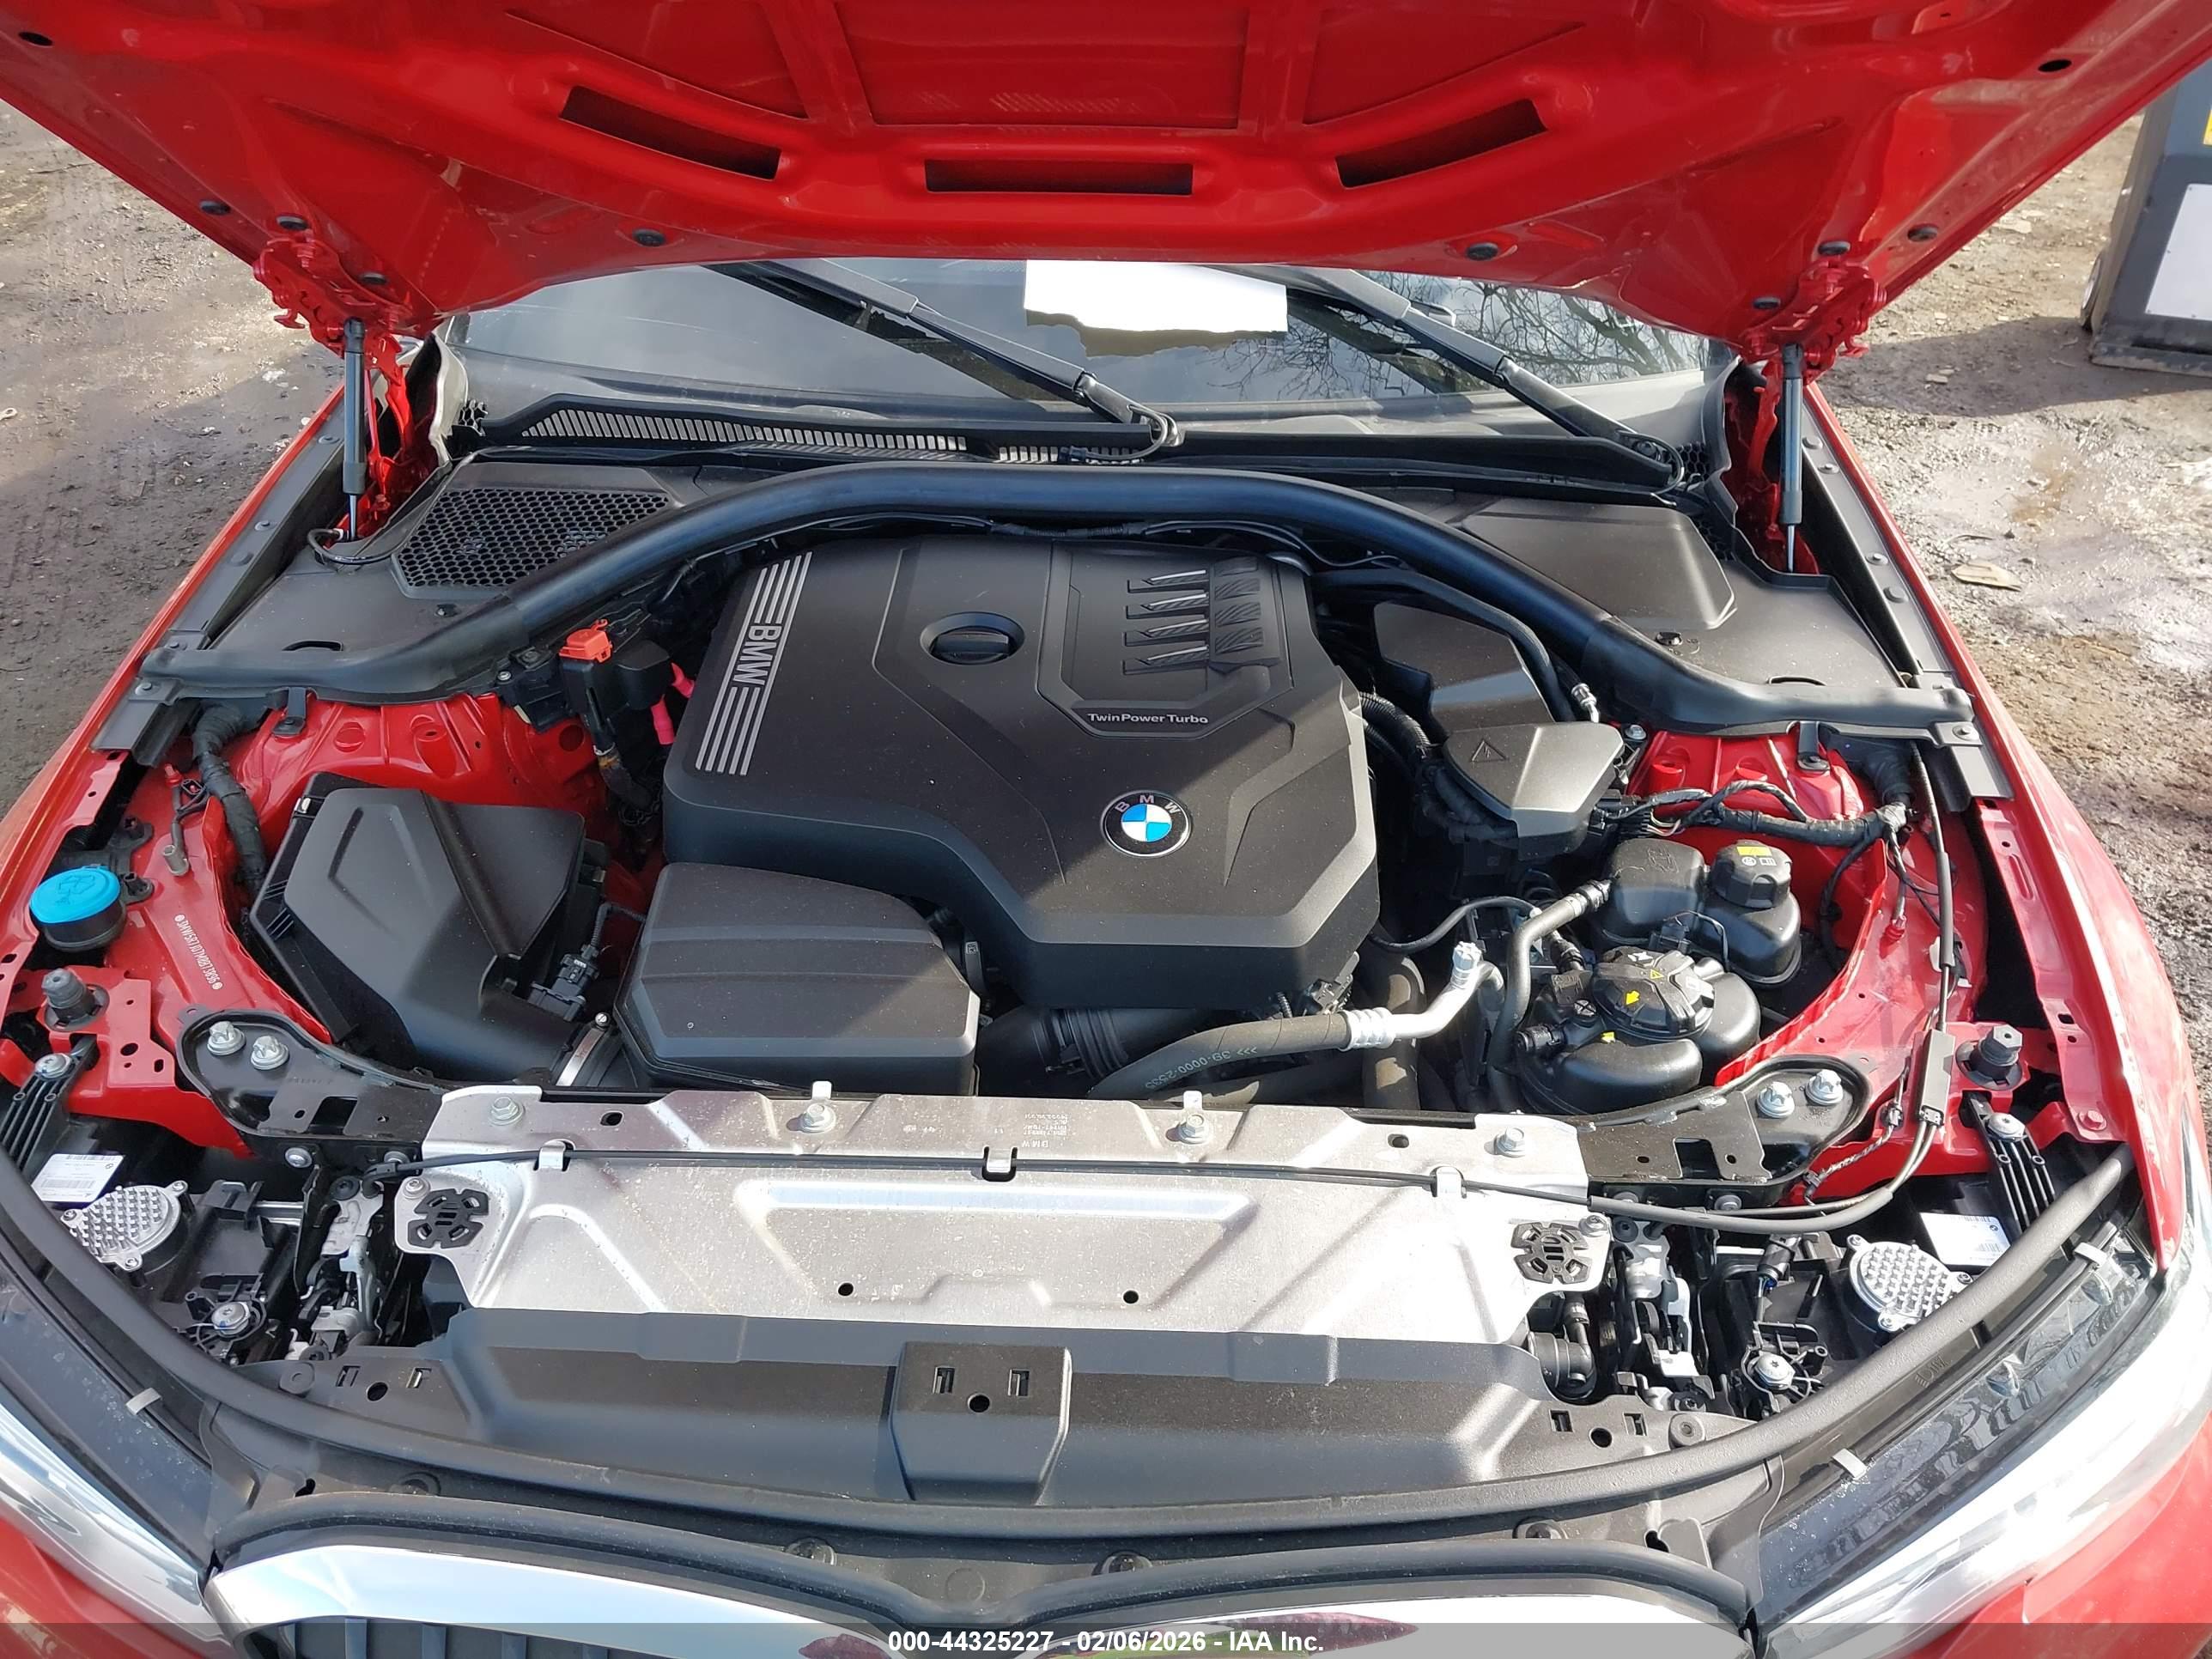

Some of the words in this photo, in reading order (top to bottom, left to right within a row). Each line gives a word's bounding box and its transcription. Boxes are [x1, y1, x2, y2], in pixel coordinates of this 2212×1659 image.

[732, 626, 782, 685] BMW
[1166, 714, 1209, 724] Turbo
[1114, 794, 1182, 814] BMW
